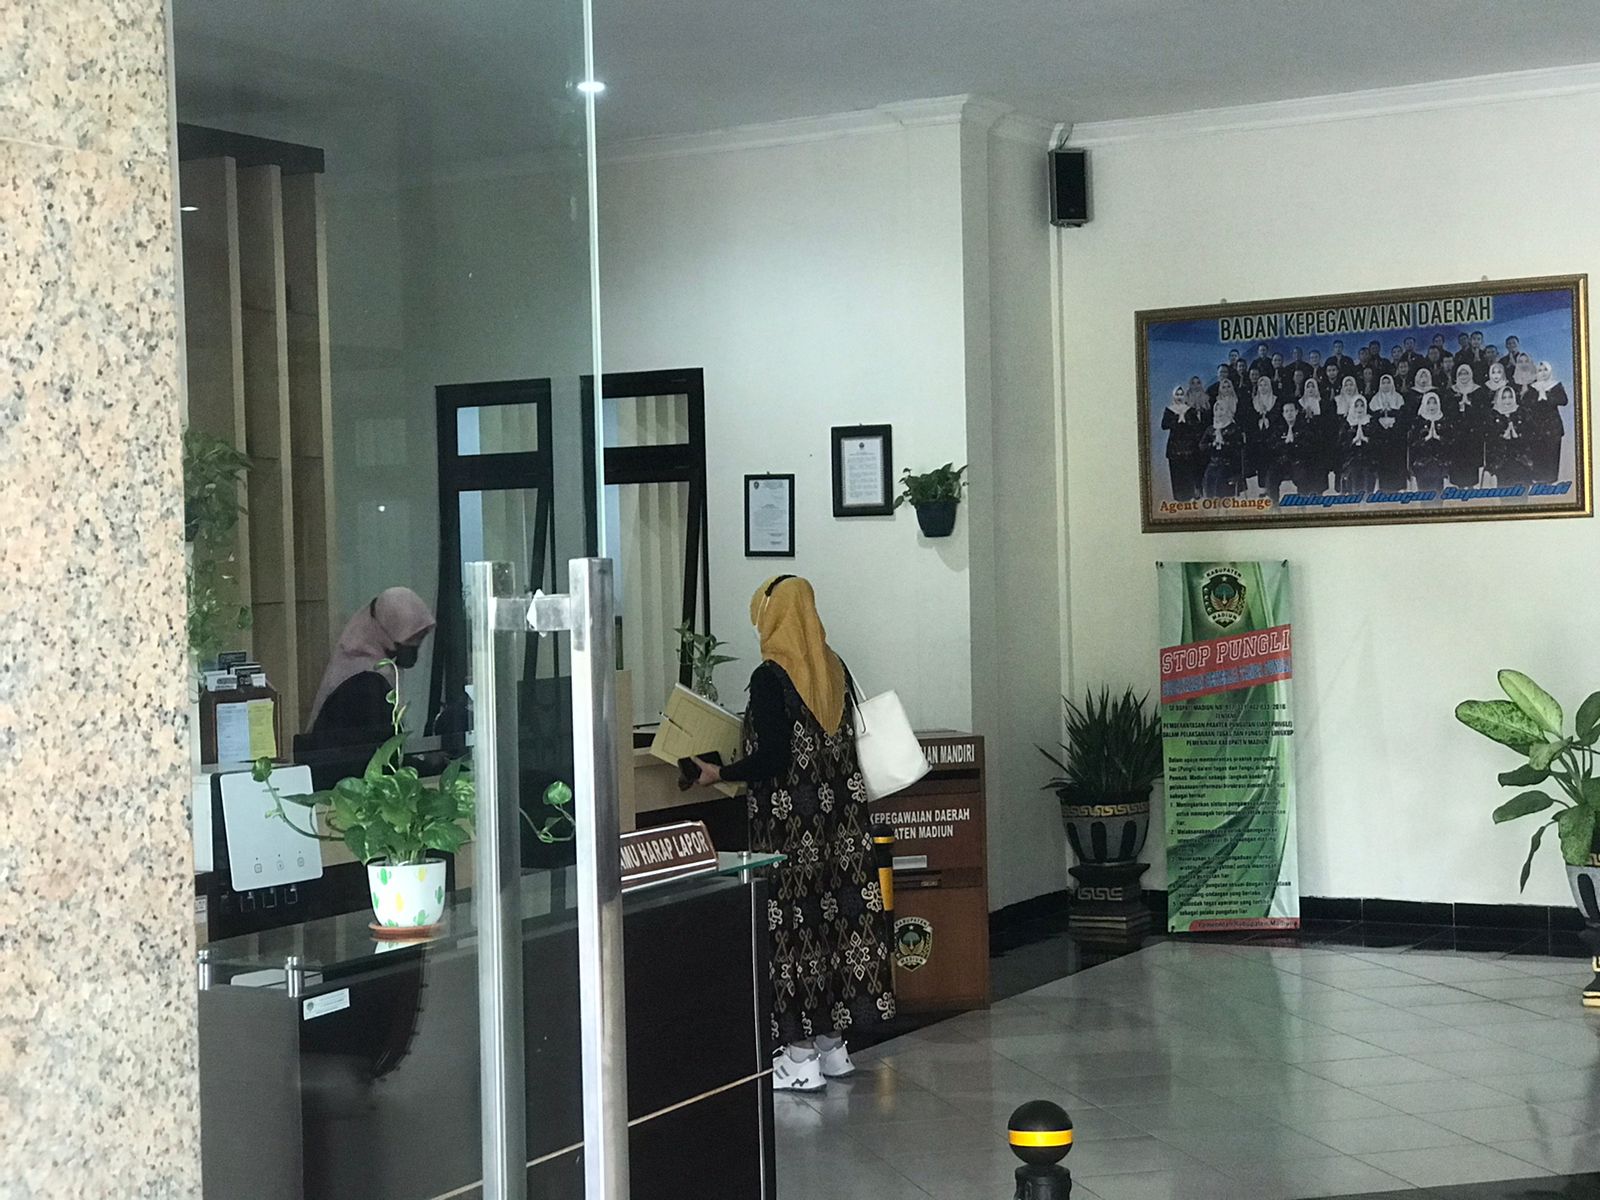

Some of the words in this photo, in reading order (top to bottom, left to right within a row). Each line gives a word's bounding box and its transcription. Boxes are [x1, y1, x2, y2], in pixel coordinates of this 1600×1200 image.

[1221, 316, 1279, 341] BADAN
[1284, 303, 1411, 336] KEPEGAWAIAN
[1418, 296, 1491, 326] DAERAH
[1440, 485, 1527, 501] Sepenuh
[1160, 501, 1198, 514] Agent
[1202, 499, 1218, 509] Of
[1221, 498, 1272, 511] Change
[1206, 567, 1242, 577] KABUPATEN
[1212, 612, 1237, 620] MADIUN
[1162, 645, 1211, 674] STOP
[1216, 629, 1290, 663] PUNGLI
[940, 744, 975, 763] MANDIRI
[870, 810, 932, 825] KEPEGAWAIAN
[935, 808, 970, 821] DAERAH
[893, 826, 916, 840] ATEN
[919, 825, 954, 838] MADIUN
[620, 844, 641, 870] AMU
[637, 837, 674, 865] HARAP
[672, 831, 709, 858] LAPOR
